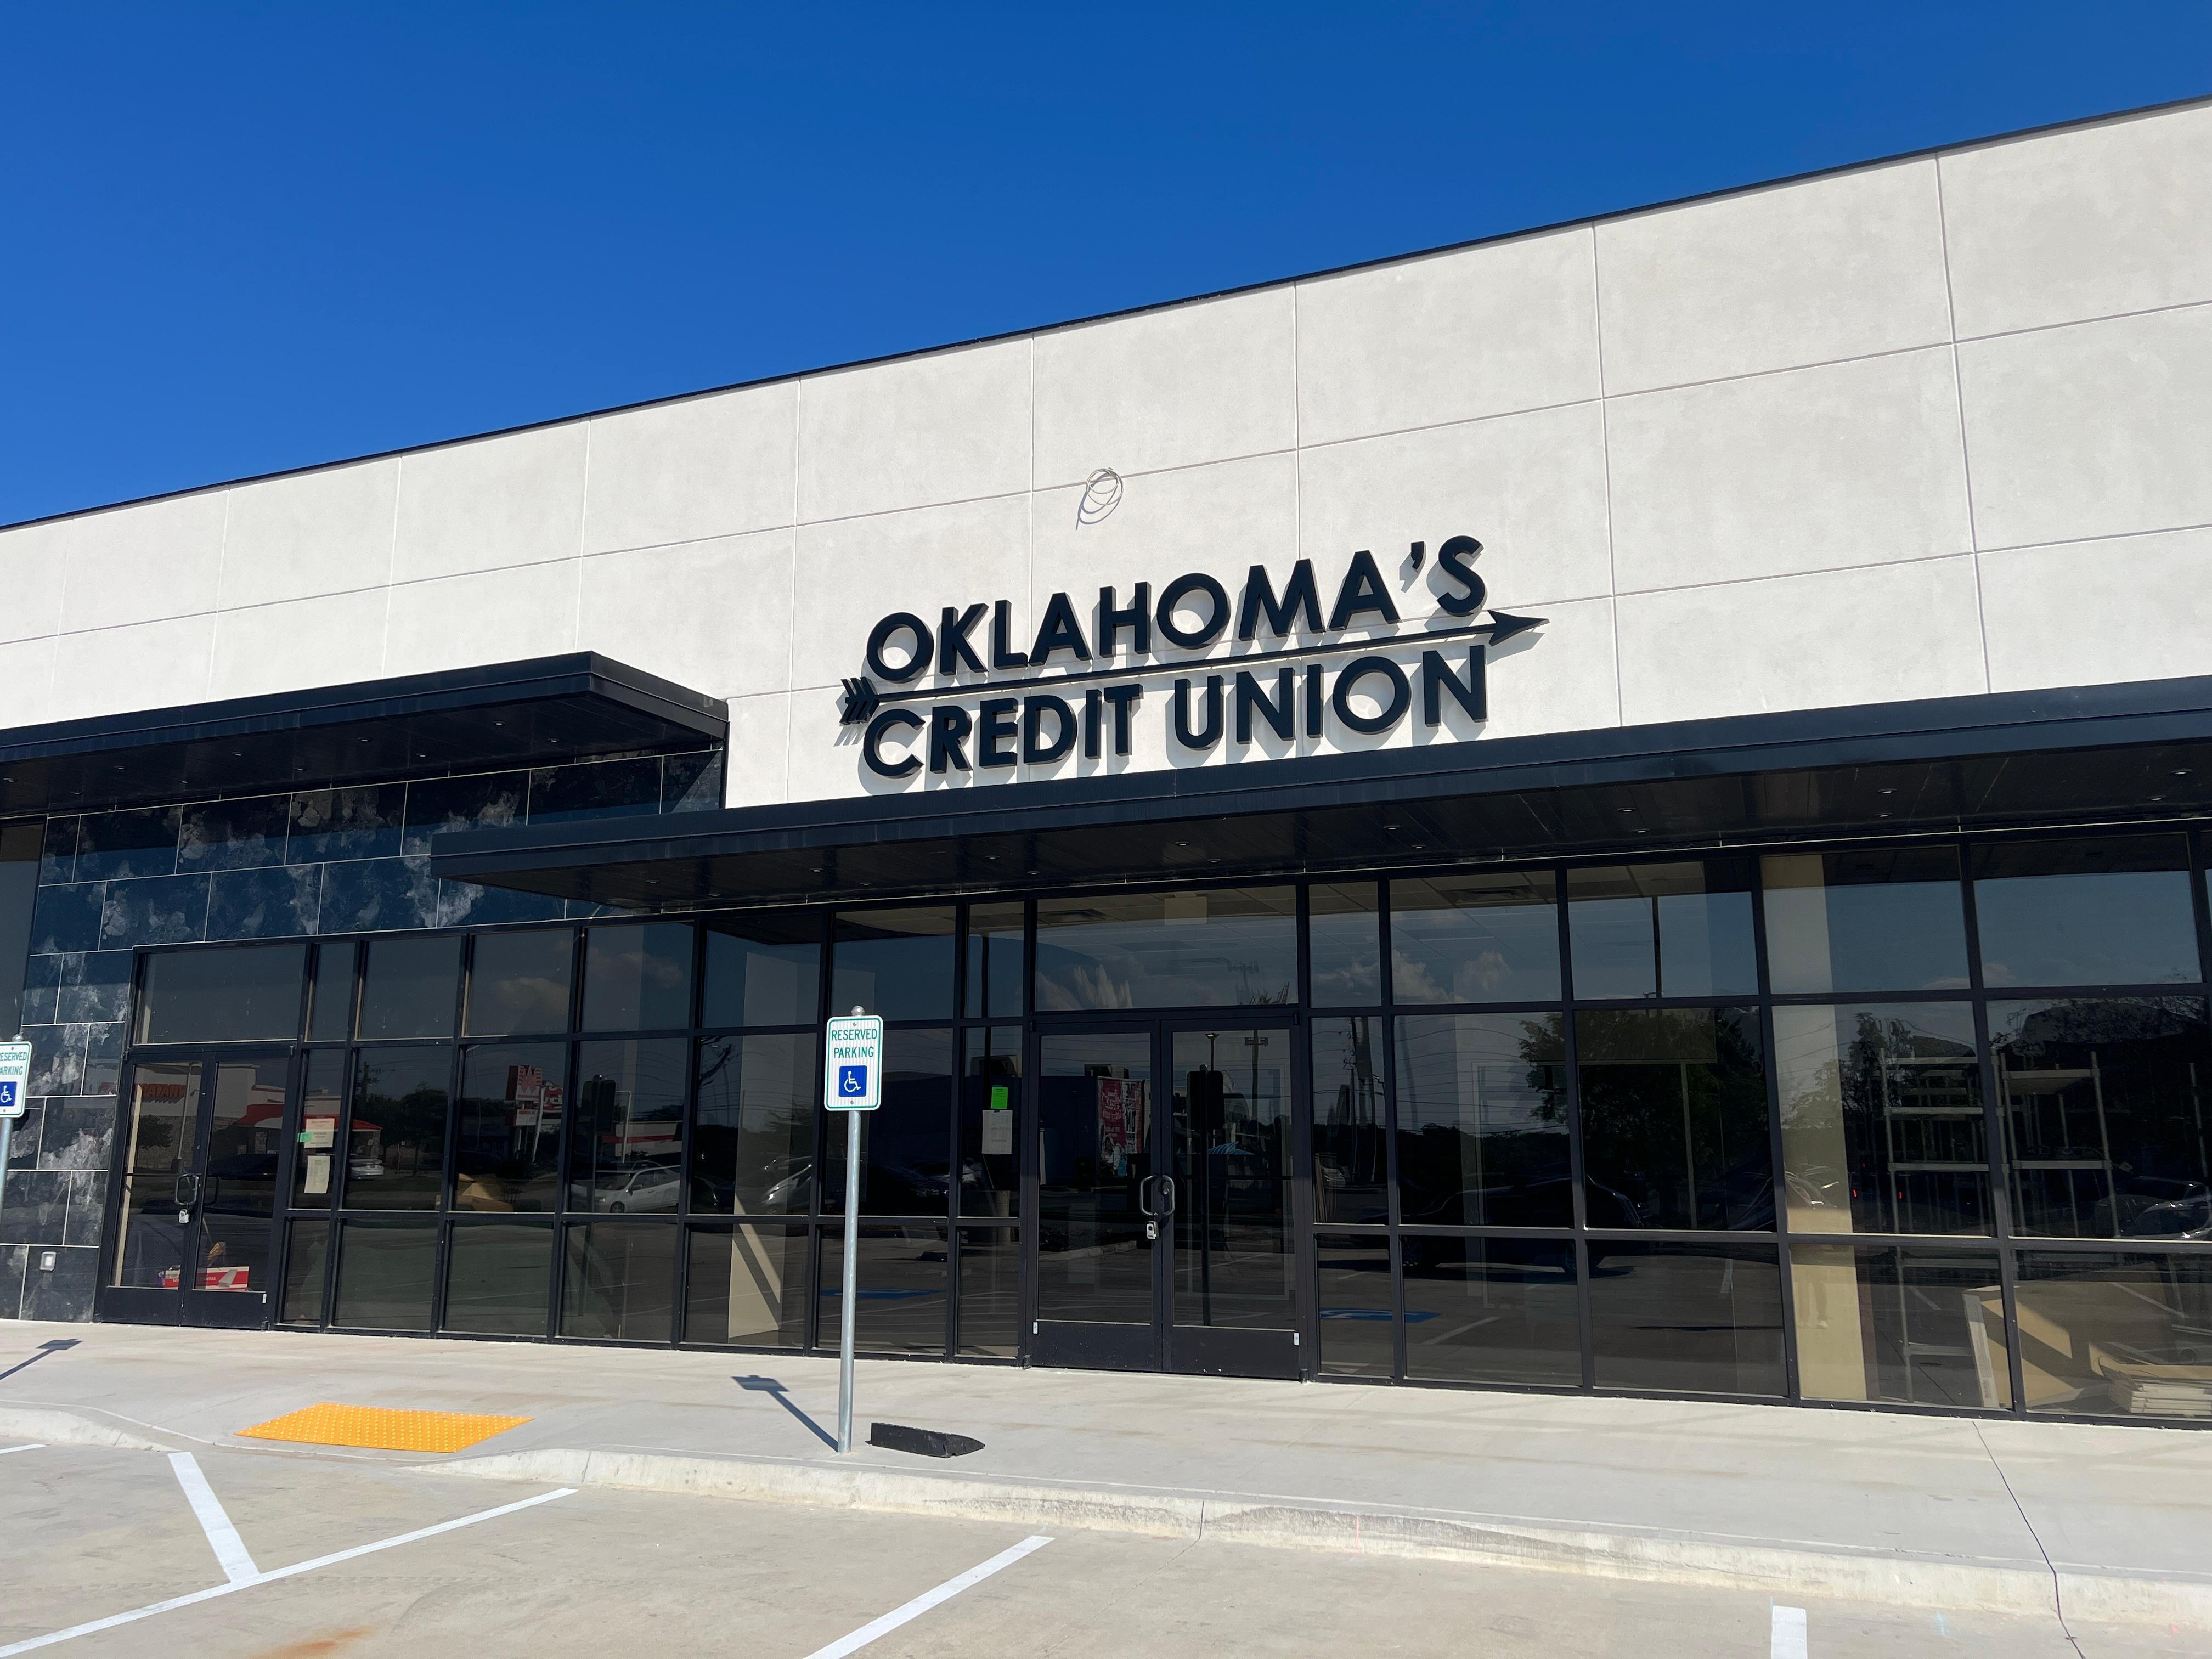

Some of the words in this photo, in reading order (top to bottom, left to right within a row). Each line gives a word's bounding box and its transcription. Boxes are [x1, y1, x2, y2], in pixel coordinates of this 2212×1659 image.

[866, 535, 1486, 684] OKLAHOMA'S
[863, 683, 1144, 779] CREDIT
[1174, 645, 1488, 752] UNION
[831, 1029, 877, 1041] RESERVED
[0, 1052, 27, 1061] ESERVED
[833, 1046, 874, 1059] PARKING
[0, 1066, 23, 1075] ARKING
